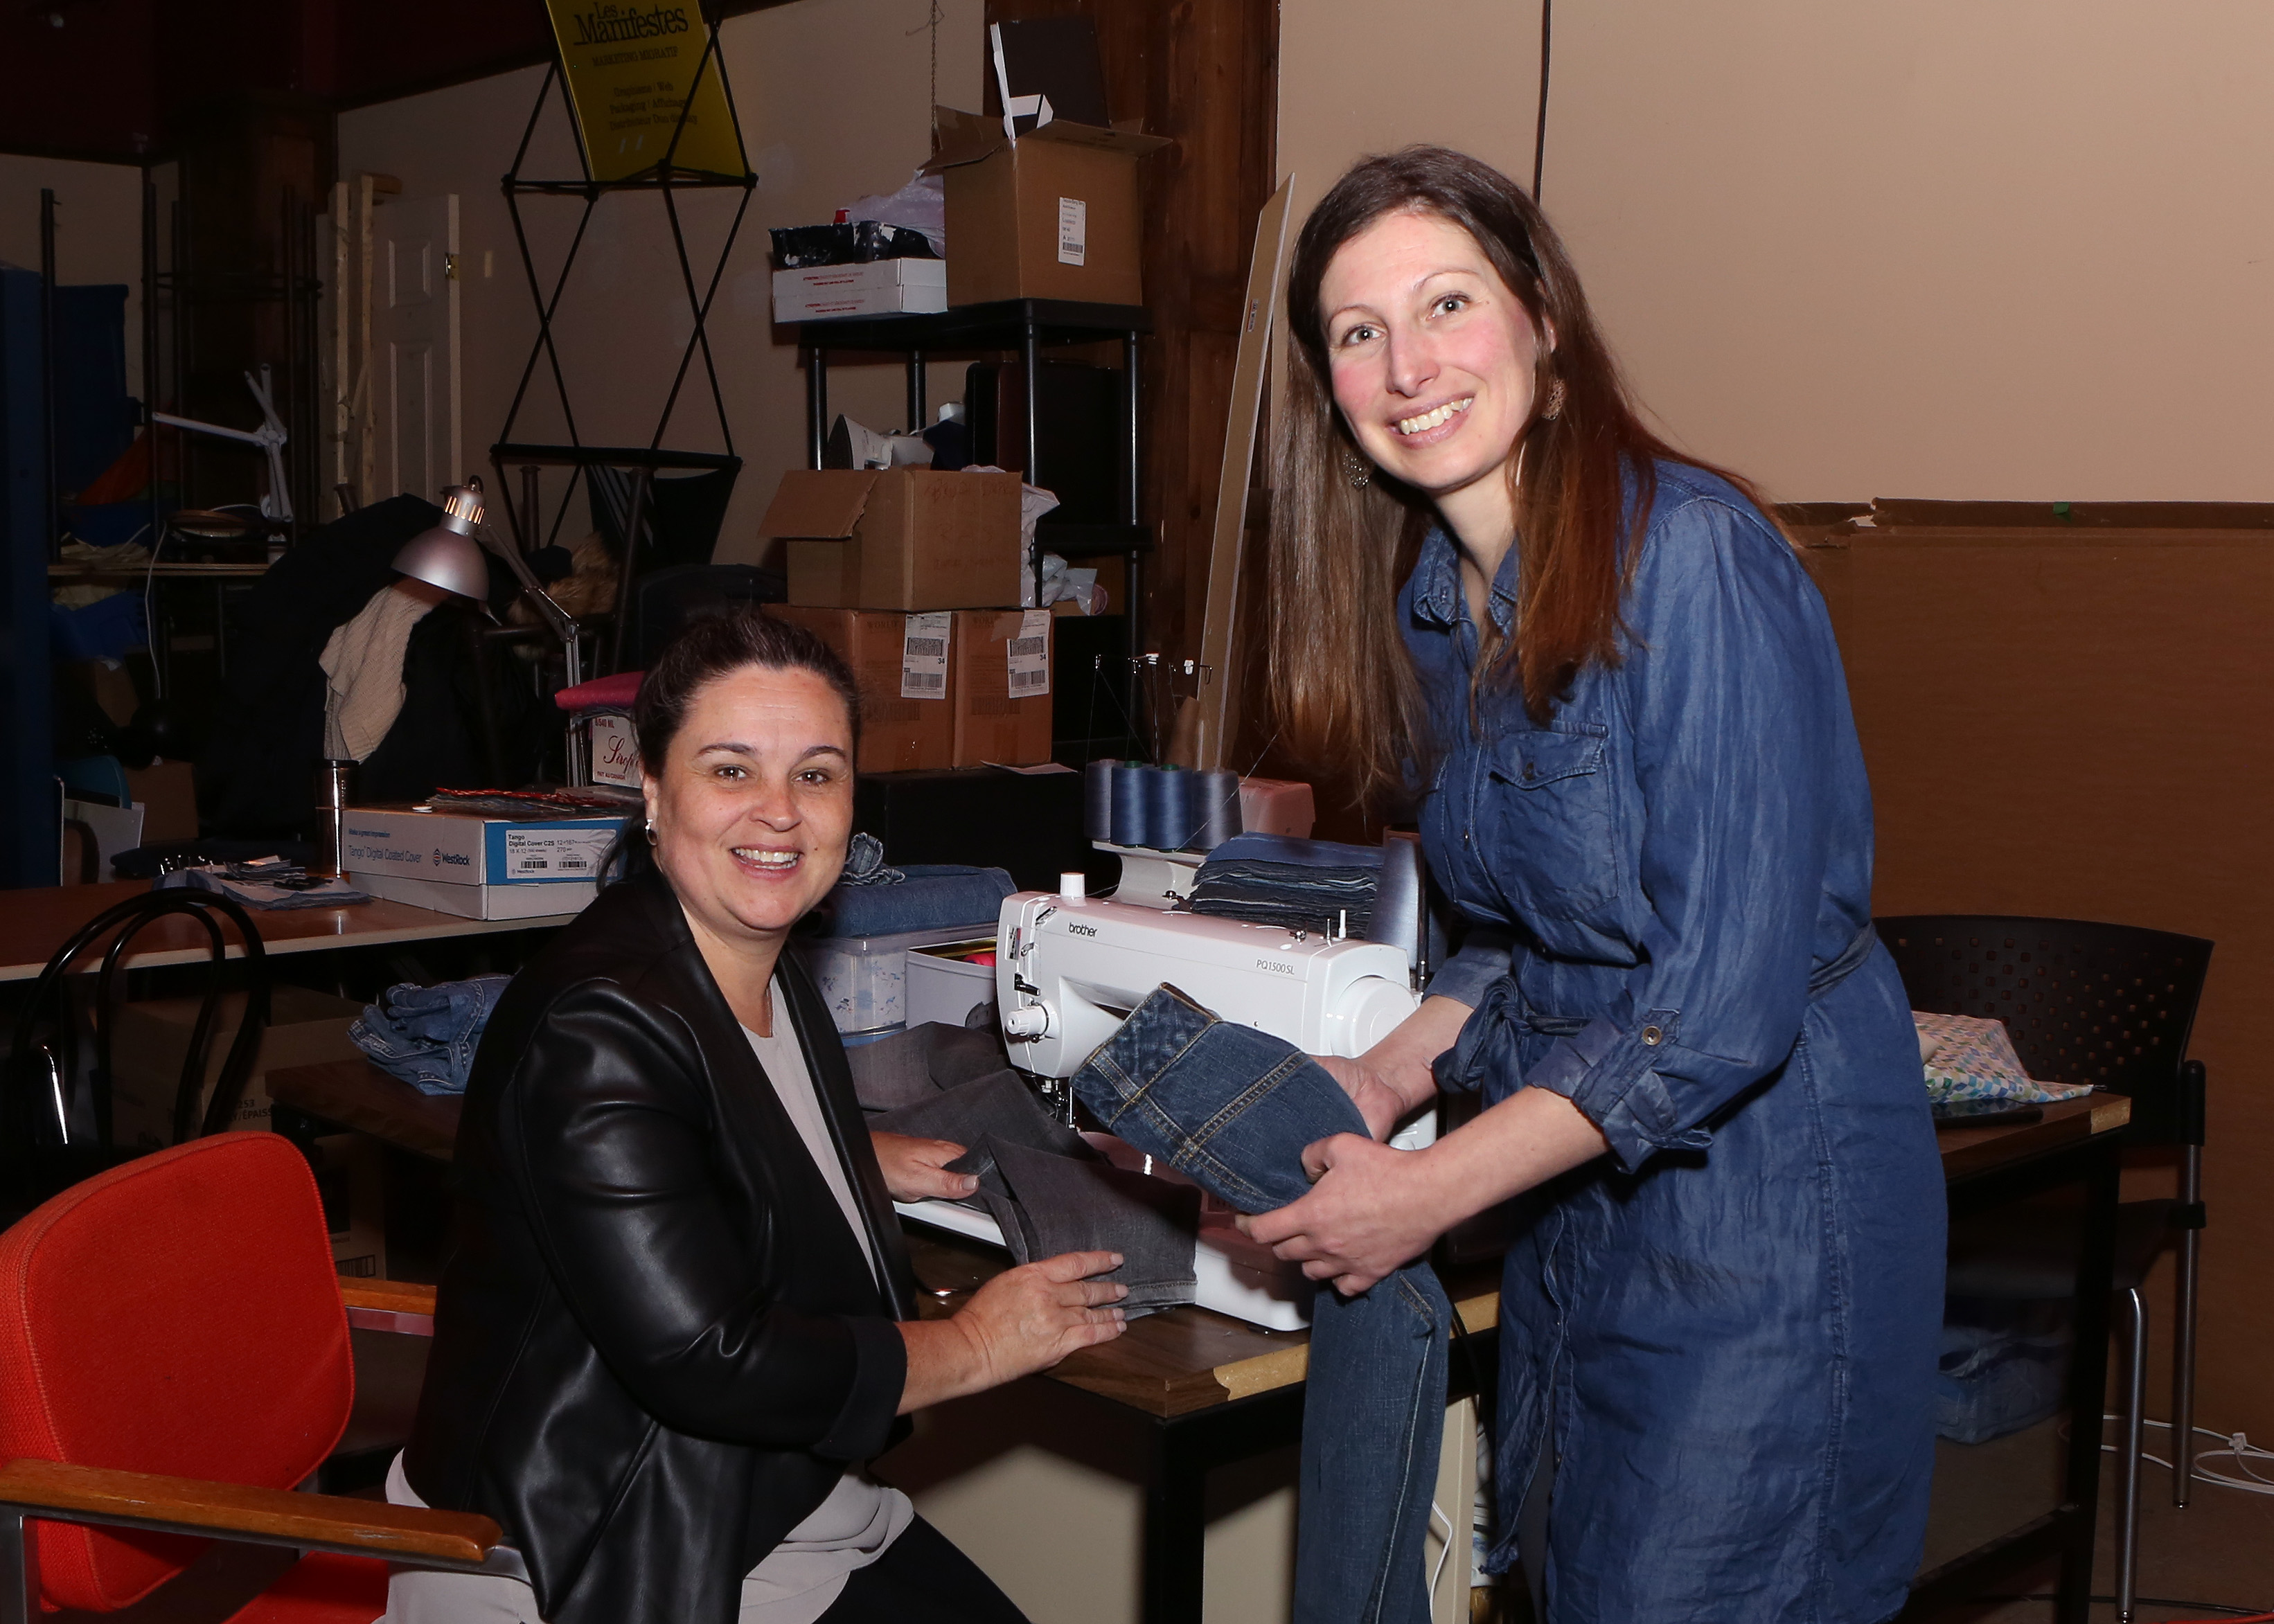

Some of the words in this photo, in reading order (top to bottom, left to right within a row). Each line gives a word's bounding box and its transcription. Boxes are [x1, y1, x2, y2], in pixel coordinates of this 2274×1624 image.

[594, 1, 618, 19] Les
[573, 3, 689, 45] Manifestes
[592, 49, 639, 66] MARKETING
[657, 82, 673, 91] Web
[366, 847, 383, 861] Digital
[384, 849, 404, 861] Coated
[405, 851, 422, 863] Cover
[442, 853, 470, 866] WestRock
[1069, 922, 1098, 937] brother
[1256, 959, 1295, 975] PQ1500SL
